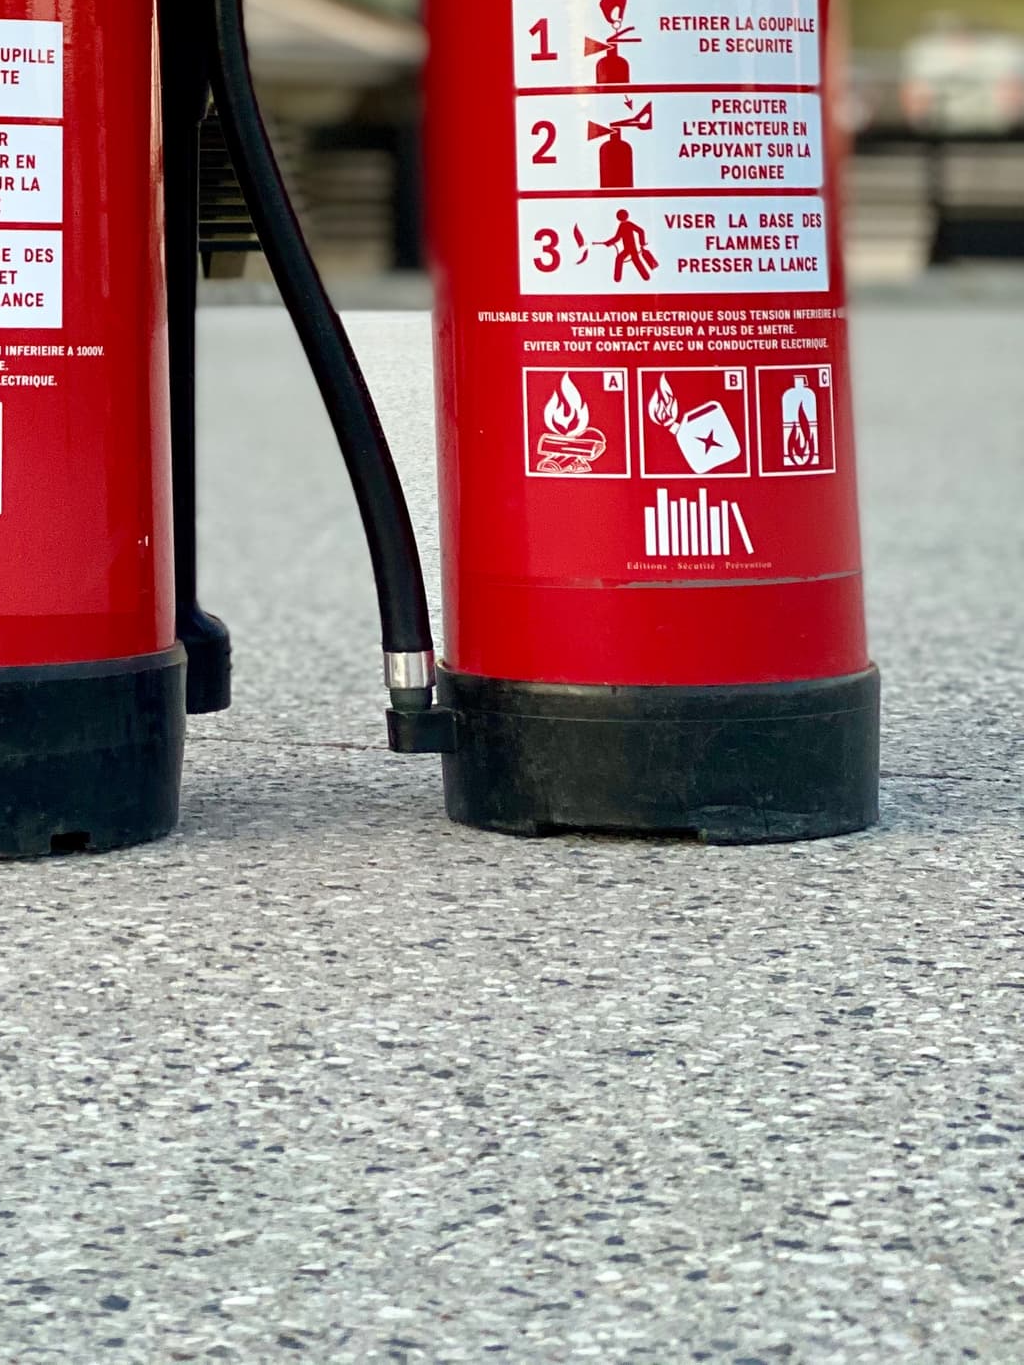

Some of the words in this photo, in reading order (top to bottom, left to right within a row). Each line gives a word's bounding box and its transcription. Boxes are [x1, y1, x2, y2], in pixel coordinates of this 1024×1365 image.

[659, 16, 730, 31] RETIRER
[735, 16, 755, 31] LA
[758, 16, 815, 33] GOUPILLE
[528, 17, 558, 62] 1
[699, 37, 721, 53] DE
[725, 37, 793, 54] SECURITE
[711, 99, 787, 115] PERCUTER
[683, 120, 789, 136] L'EXTINCTEUR
[793, 121, 807, 137] EN
[531, 120, 557, 165] 2
[678, 142, 763, 158] APPUYANT
[767, 142, 794, 158] SUR
[797, 143, 811, 158] LA
[16, 154, 36, 170] EN
[720, 164, 785, 180] POIGNEE
[21, 176, 41, 192] LA
[664, 213, 716, 229] VISER
[728, 213, 748, 229] LA
[759, 213, 794, 228] BASE
[802, 213, 822, 229] DES
[533, 228, 561, 273] 3
[705, 234, 781, 251] FLAMMES
[784, 234, 800, 250] ET
[24, 248, 54, 263] DES
[677, 257, 753, 273] PRESSER
[758, 257, 776, 273] LA
[780, 256, 818, 272] LANCE
[478, 311, 529, 323] UTILISABLE
[531, 311, 554, 323] SUR
[556, 311, 638, 323] INSTALLATION
[641, 310, 714, 323] ELECTRIQUE
[716, 309, 747, 321] SOUS
[749, 309, 791, 321] TENSION
[570, 326, 606, 337] TENIR
[608, 326, 623, 337] LE
[626, 325, 694, 337] DIFFUSEUR
[697, 325, 706, 336] A
[708, 325, 738, 336] PLUS
[741, 324, 755, 336] DE
[5, 345, 65, 356] INFERIEIRE
[66, 345, 74, 356] A
[76, 345, 104, 357] 1000V.
[523, 340, 561, 352] EVITER
[562, 340, 593, 352] TOUT
[595, 340, 650, 352] CONTACT
[653, 340, 684, 352] AVEC
[687, 340, 704, 351] UN
[707, 338, 779, 351] CONDUCTEUR
[608, 375, 619, 389] A
[728, 373, 738, 387] B
[821, 370, 828, 385] C
